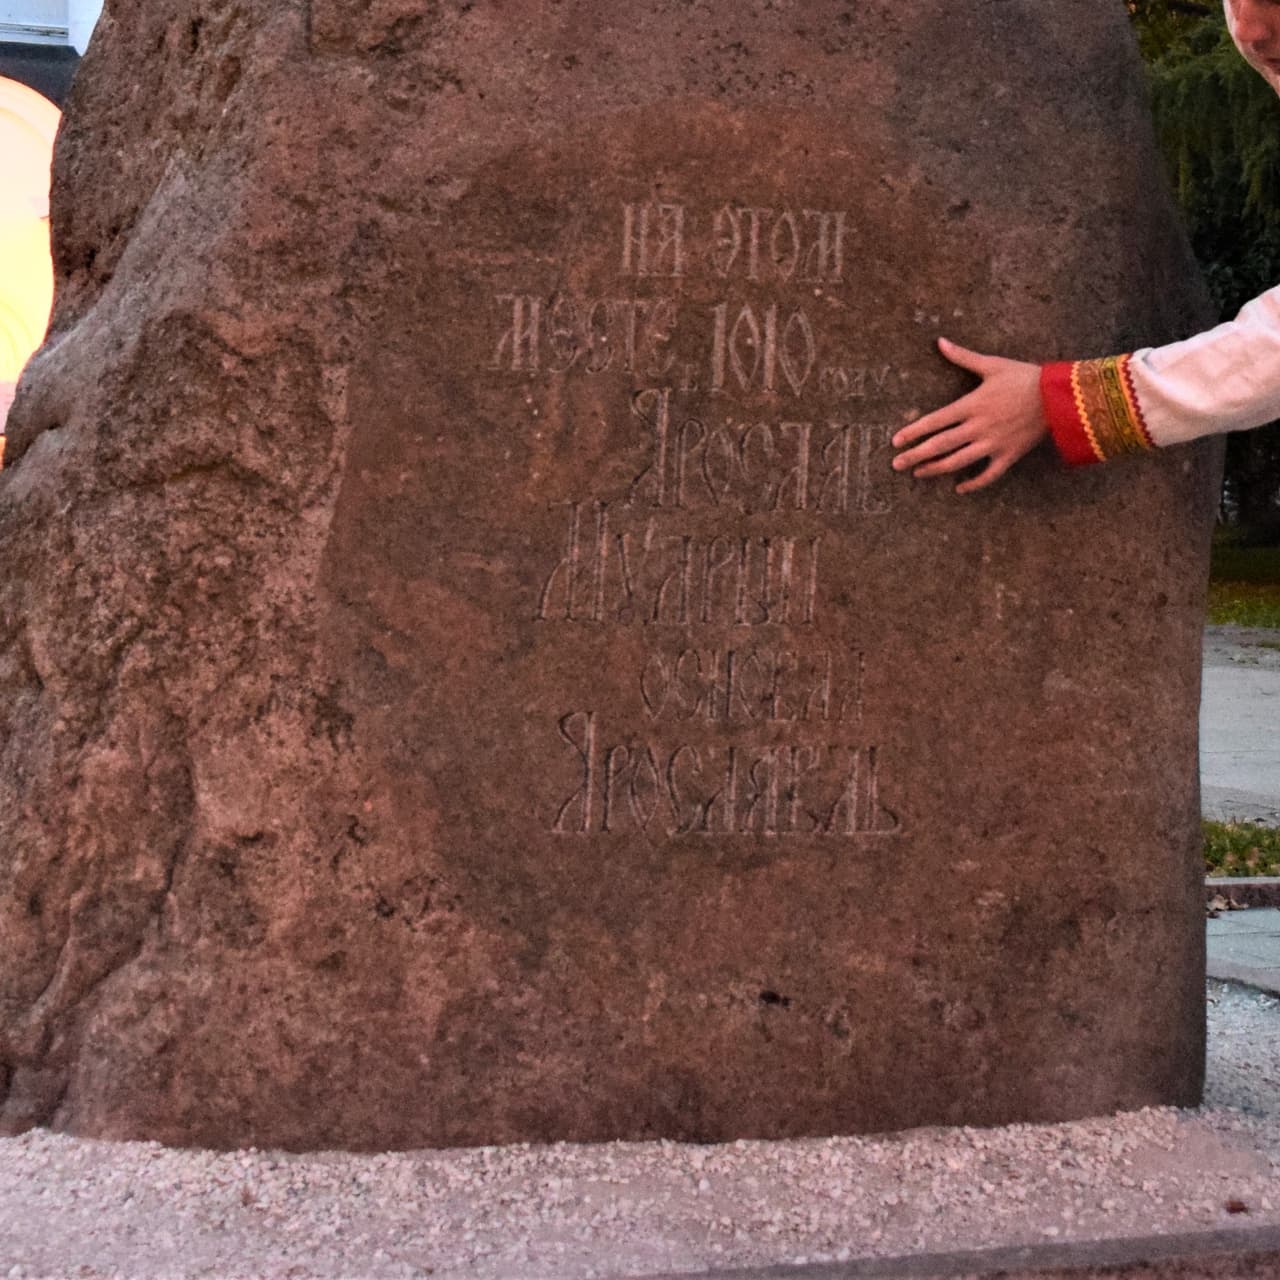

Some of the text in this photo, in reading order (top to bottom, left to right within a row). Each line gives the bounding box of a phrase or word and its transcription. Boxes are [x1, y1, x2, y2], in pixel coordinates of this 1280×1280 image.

[621, 203, 848, 284] НА ЭТОМ
[710, 302, 816, 397] 1010
